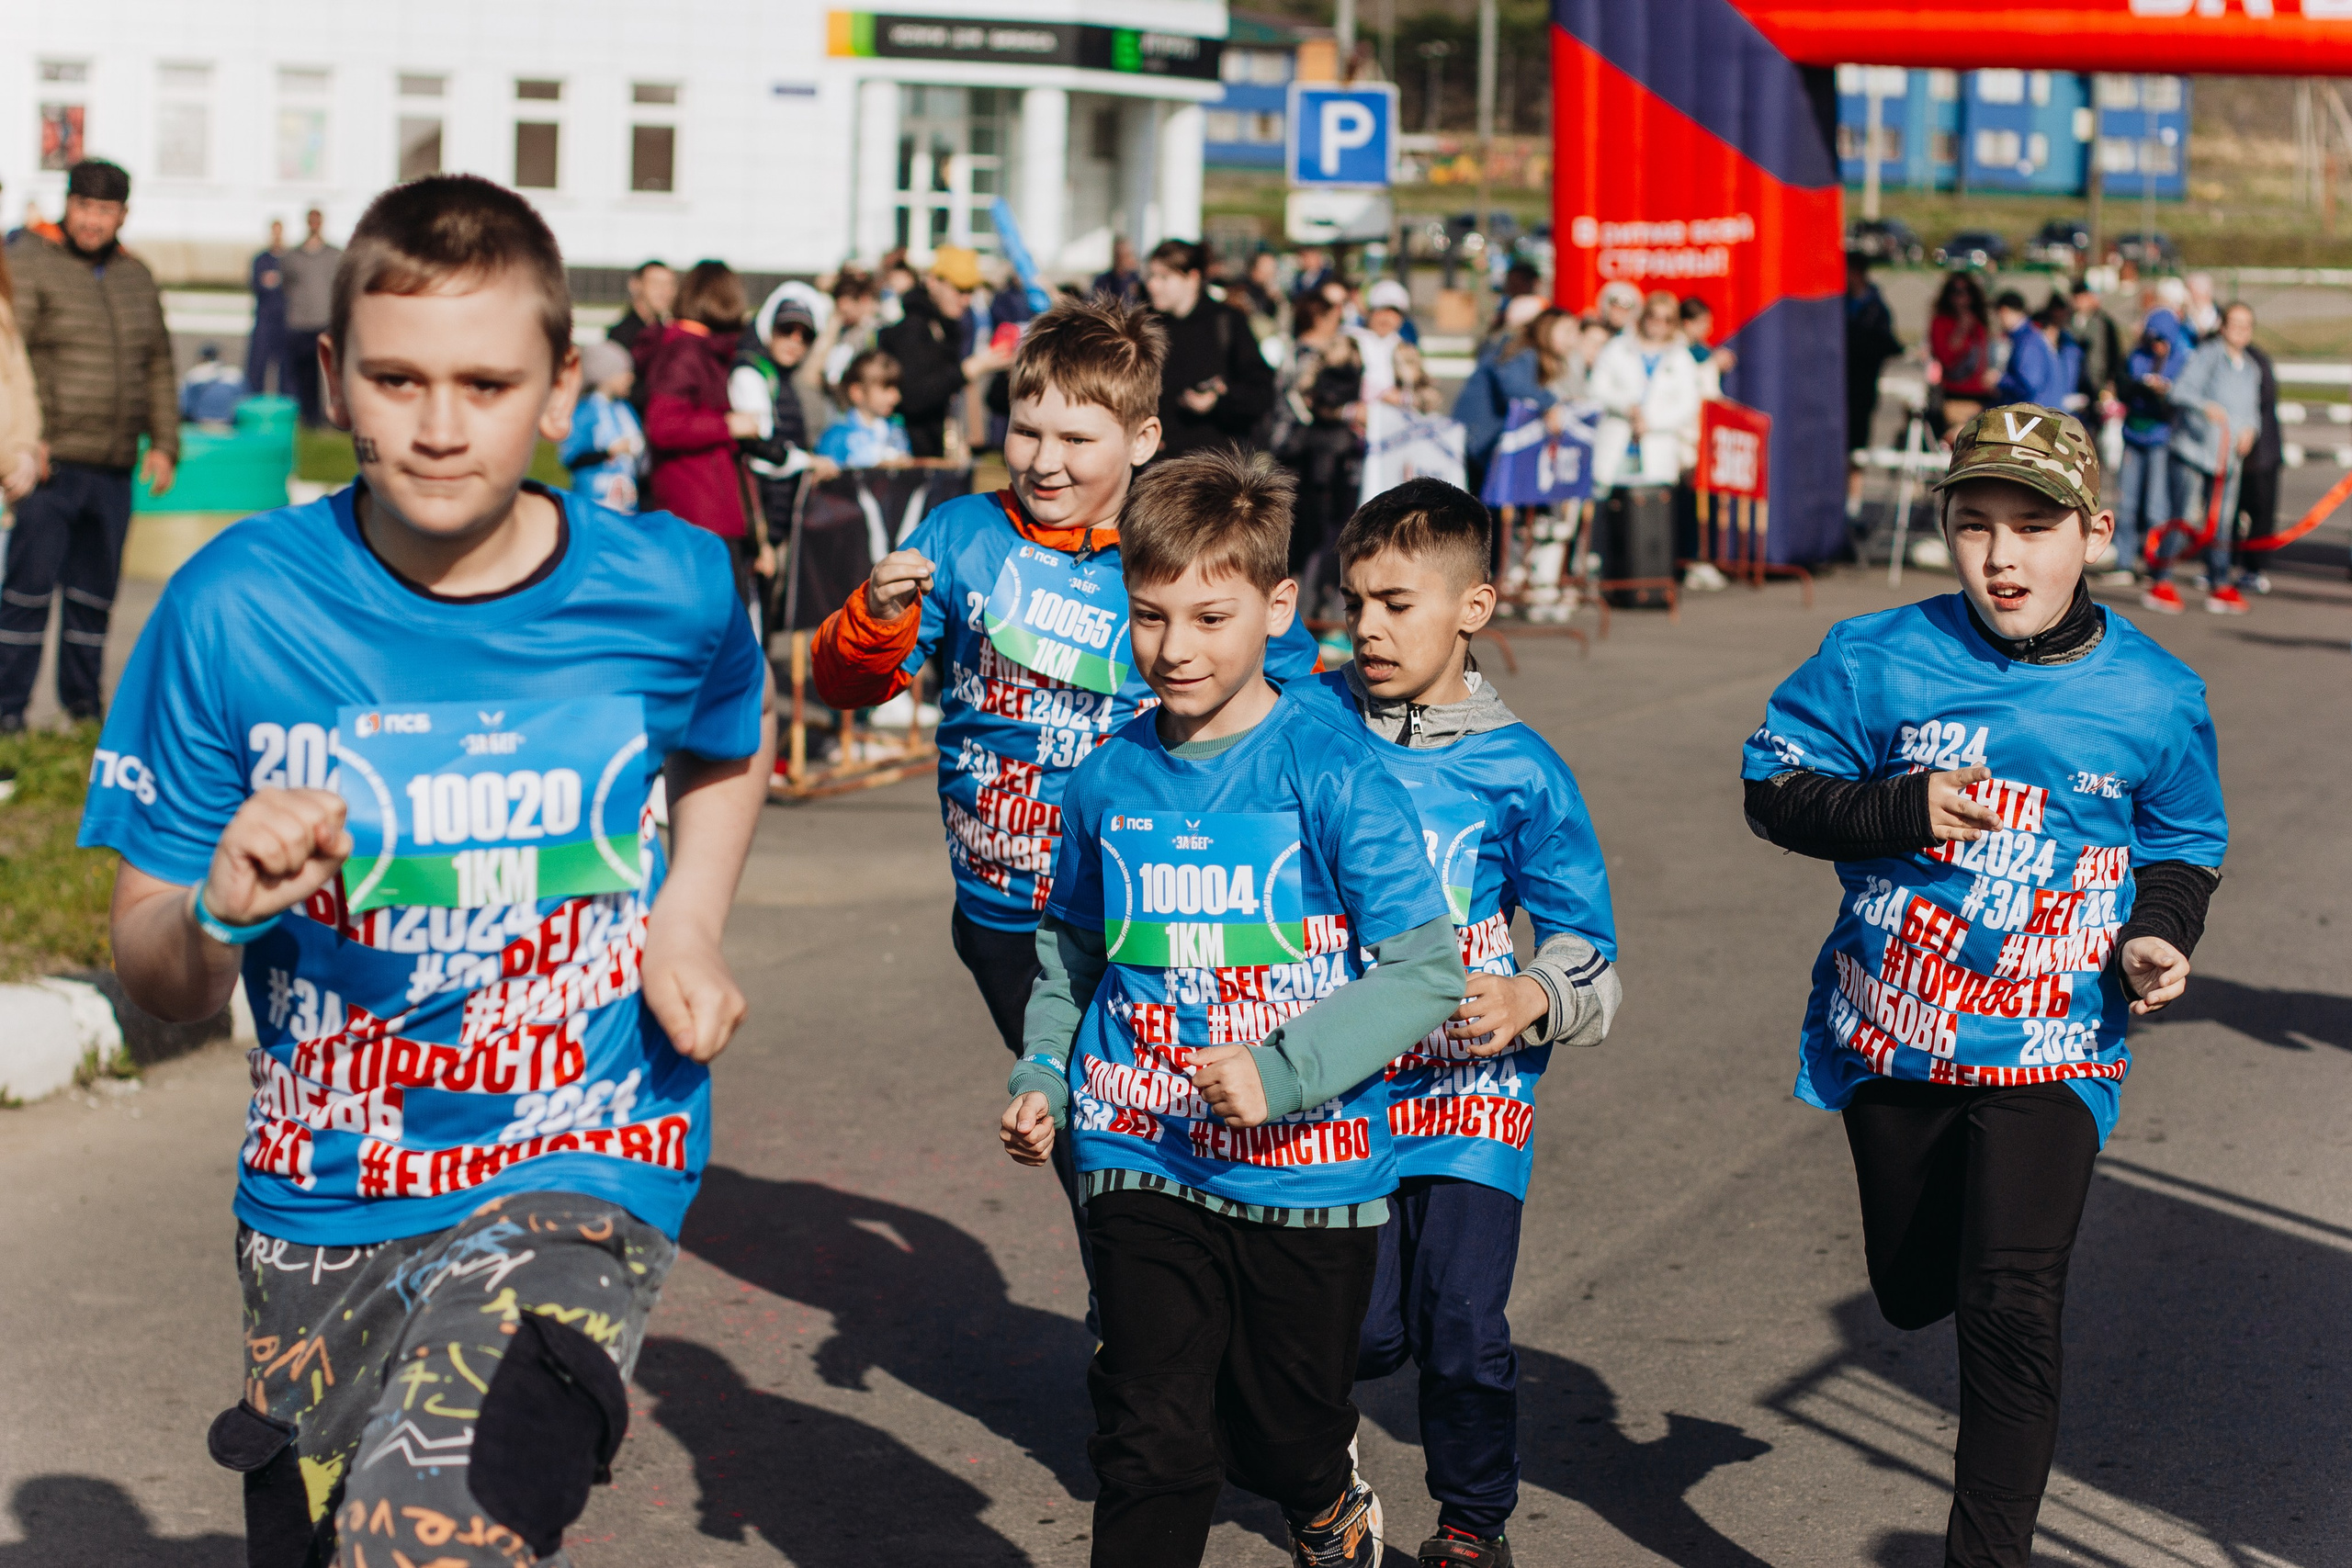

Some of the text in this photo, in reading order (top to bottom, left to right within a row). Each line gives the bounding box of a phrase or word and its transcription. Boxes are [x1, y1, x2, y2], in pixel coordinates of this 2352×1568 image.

[1320, 102, 1376, 176] P
[2004, 412, 2043, 443] V
[1034, 550, 1059, 568] ПСБ
[1023, 588, 1118, 649] 10055
[385, 713, 432, 734] ПСБ
[1901, 719, 1990, 771] 2024
[89, 748, 157, 806] ПСБ
[406, 768, 582, 846] 10020
[1126, 818, 1153, 831] ПСБ
[1139, 863, 1260, 915] 10004
[1852, 874, 1971, 963] #ЗАБЕГ
[1163, 952, 1350, 1005] #ЗАБЕГ2024
[1880, 934, 2073, 1019] #ГОРДОСТЬ
[1833, 948, 1959, 1060] #ЛЮБОВЬ
[1080, 1053, 1208, 1120] #ЛЮБОВЬ
[1430, 1055, 1522, 1097] 2024
[1190, 1117, 1369, 1167] #ЕДИНСТВО
[1332, 1499, 1364, 1533] CROSBY
